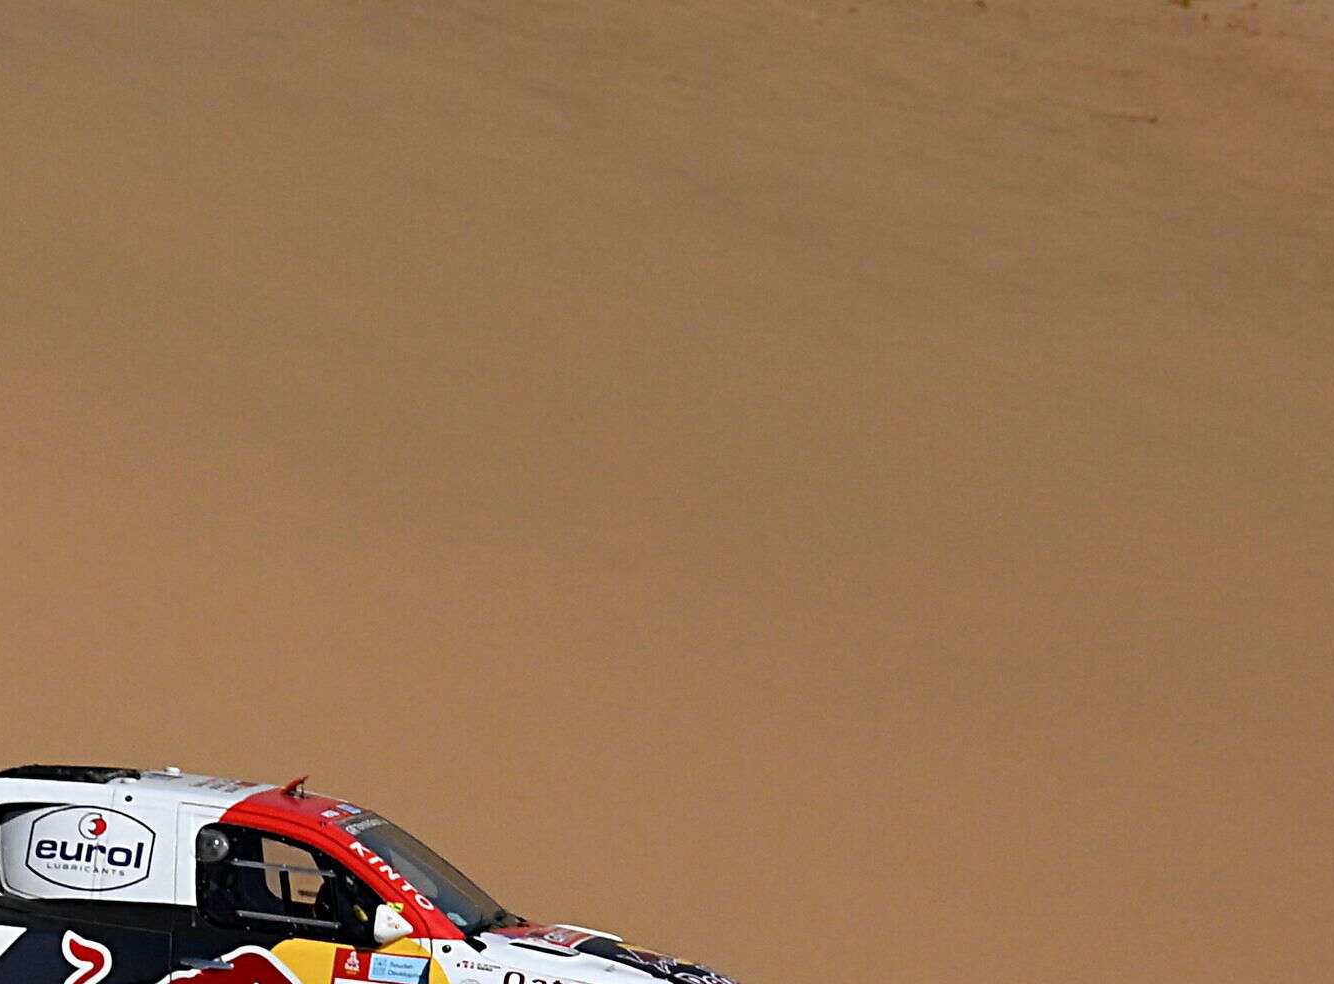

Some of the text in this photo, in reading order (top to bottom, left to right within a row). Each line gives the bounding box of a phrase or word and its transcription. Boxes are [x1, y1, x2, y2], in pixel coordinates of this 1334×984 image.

[35, 839, 145, 869] eurol
[46, 862, 126, 877] LUBRICANTS
[349, 841, 435, 910] KINTO
